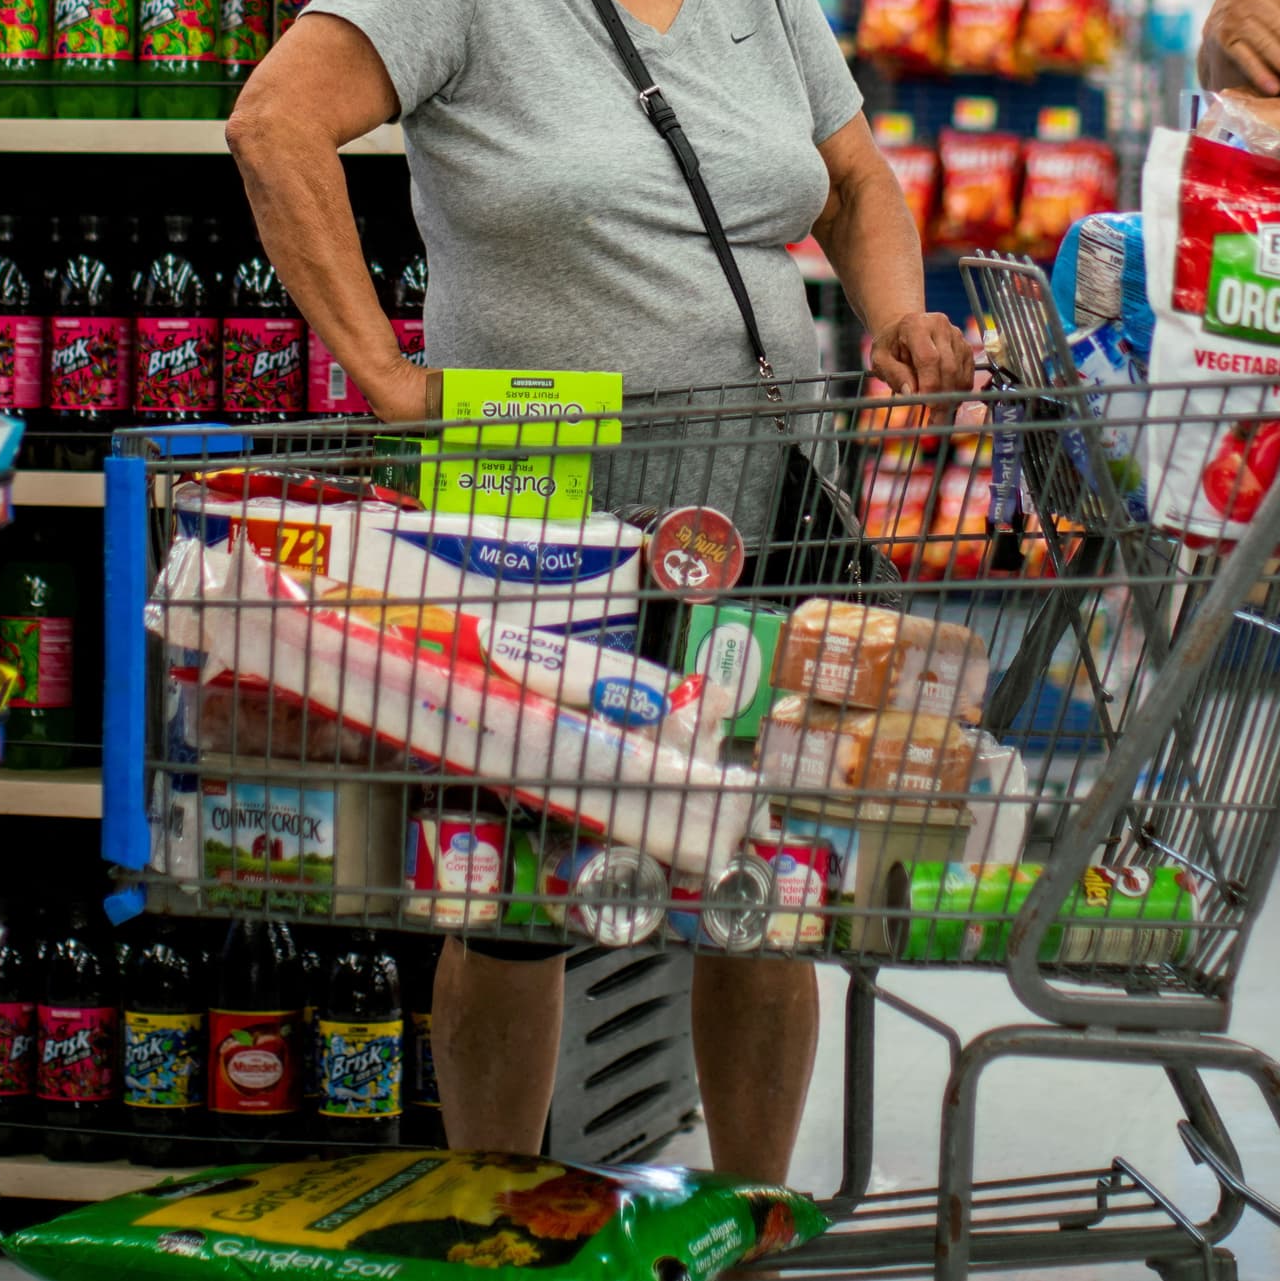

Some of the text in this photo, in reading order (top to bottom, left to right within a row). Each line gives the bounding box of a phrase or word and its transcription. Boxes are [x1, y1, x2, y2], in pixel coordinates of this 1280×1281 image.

[505, 391, 560, 399] FRUIT BARS
[512, 379, 553, 387] STRAWBERRY
[482, 401, 584, 425] Outshine
[481, 462, 534, 471] FRUIT BARS
[458, 473, 556, 498] Outshine
[279, 528, 325, 566] 72
[479, 545, 583, 571] MEGA ROLLS
[500, 629, 565, 655] Bread
[495, 641, 563, 671] Garlic
[602, 690, 659, 720] Great
[606, 681, 649, 704] Value
[271, 812, 326, 844] CROCK
[783, 894, 804, 905] Milk
[211, 1238, 334, 1272] Garden
[336, 1256, 402, 1280] Soil
